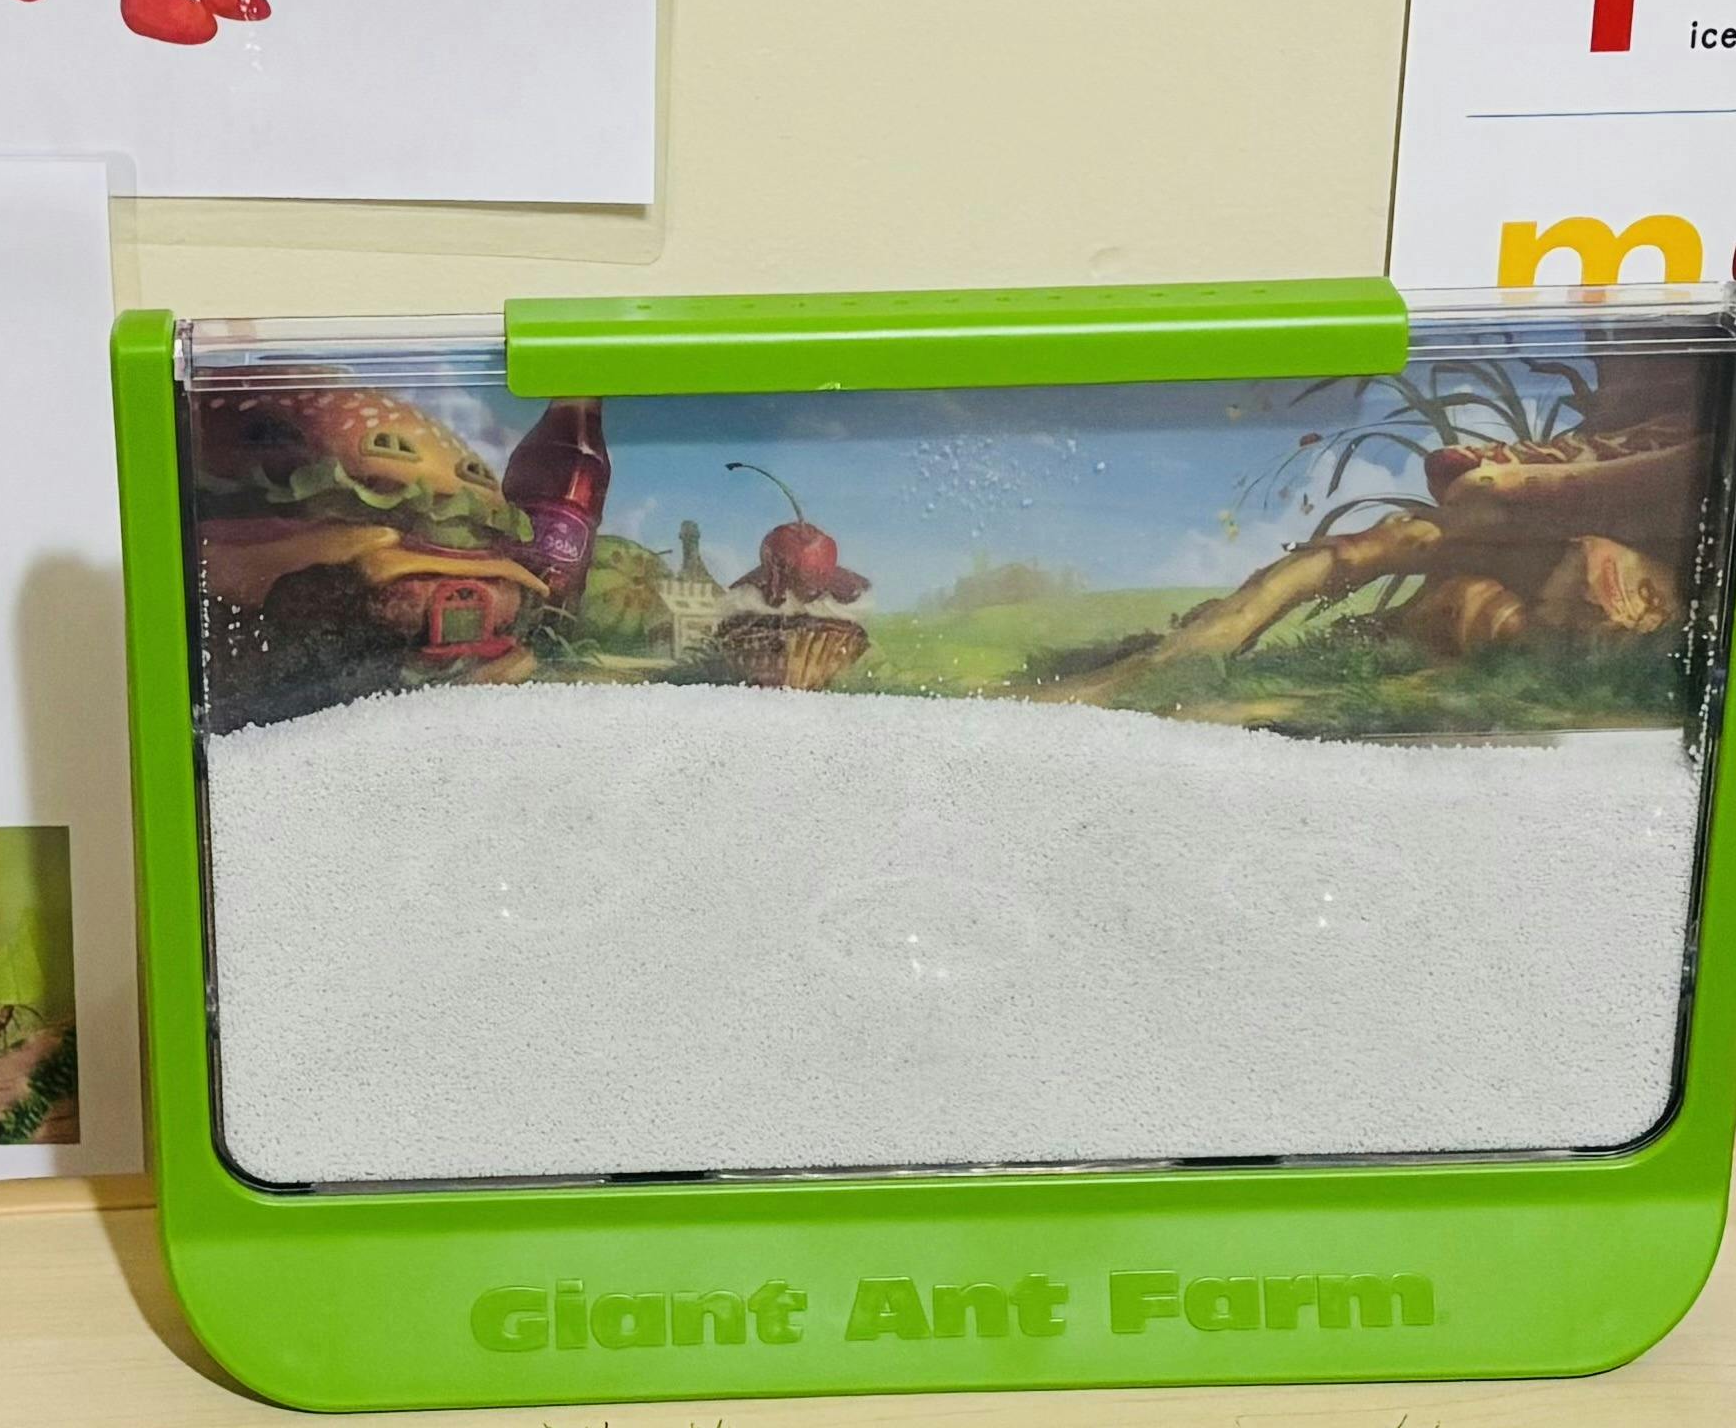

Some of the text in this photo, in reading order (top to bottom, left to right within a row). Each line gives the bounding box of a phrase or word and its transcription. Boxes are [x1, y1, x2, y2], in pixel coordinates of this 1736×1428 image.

[469, 1268, 1436, 1354] Giant Ant Farm
